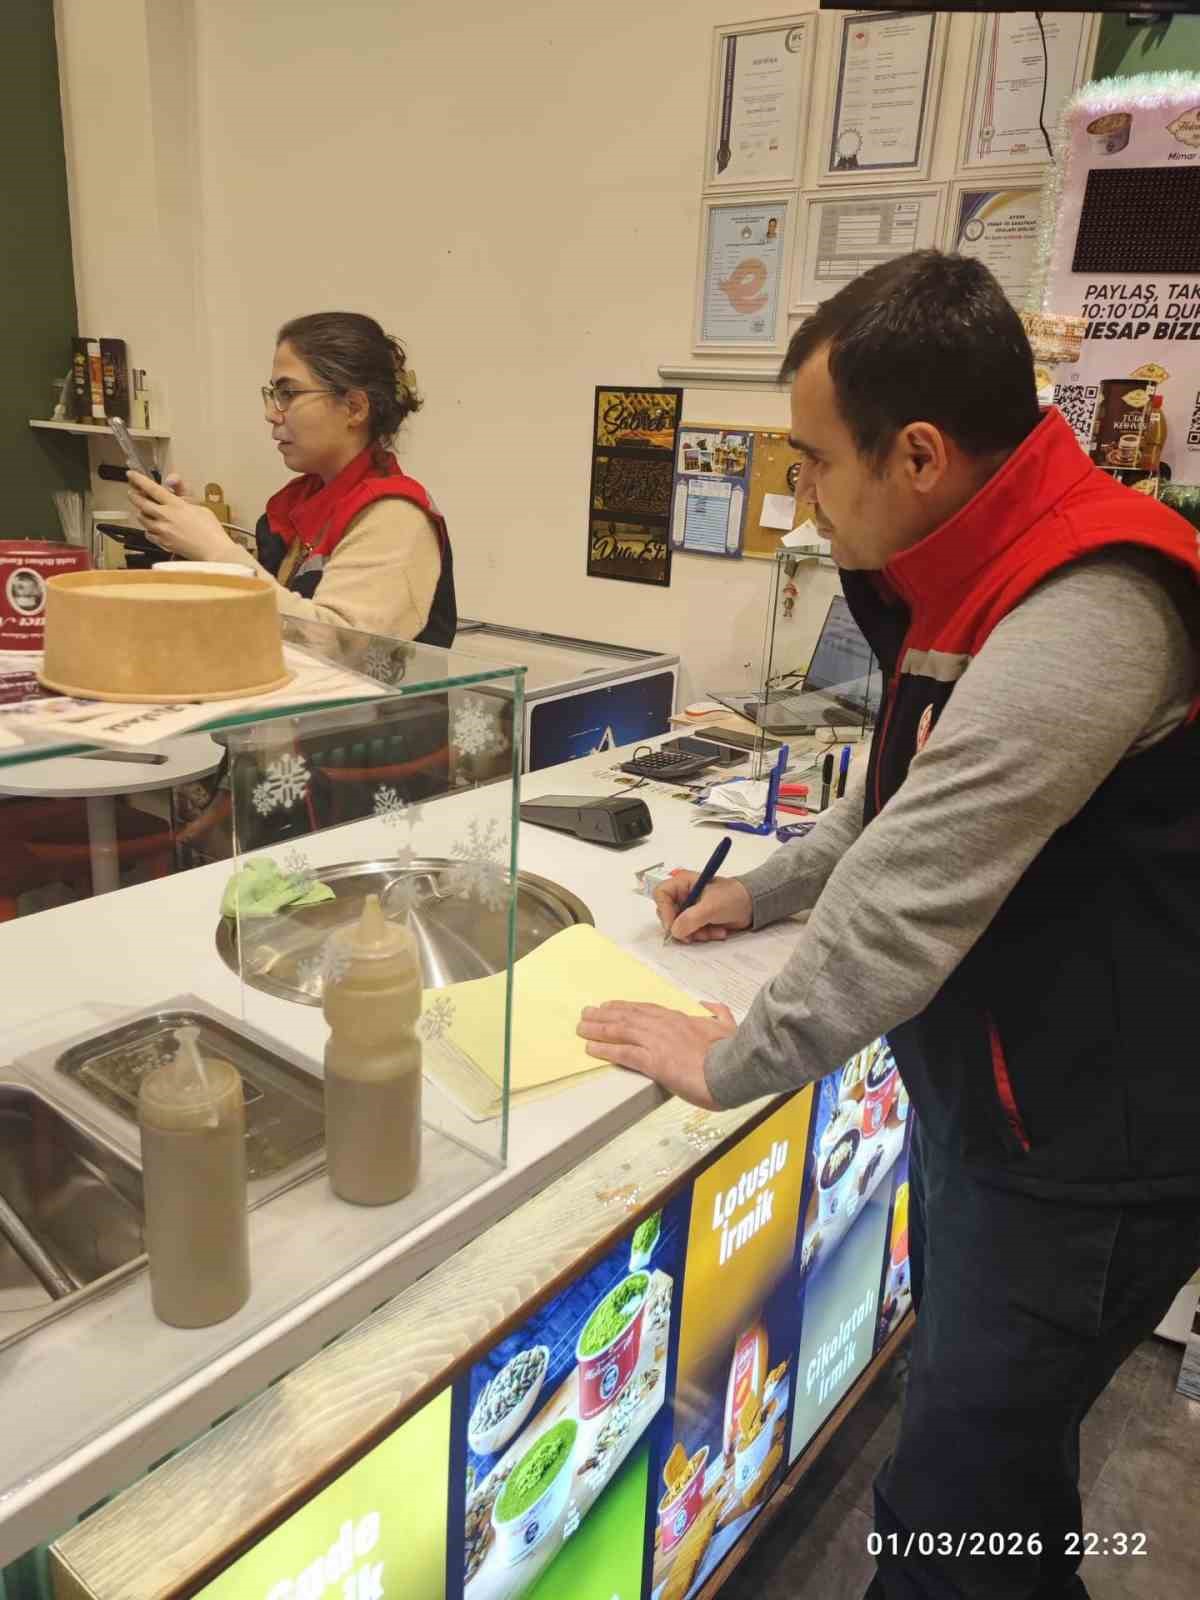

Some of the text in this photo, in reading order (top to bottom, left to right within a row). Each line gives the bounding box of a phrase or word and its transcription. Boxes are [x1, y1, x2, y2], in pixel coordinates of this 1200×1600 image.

[1085, 283, 1159, 304] PAYLAŞ,
[1081, 303, 1159, 319] 10:10'DA
[711, 1139, 788, 1232] Lotuslu
